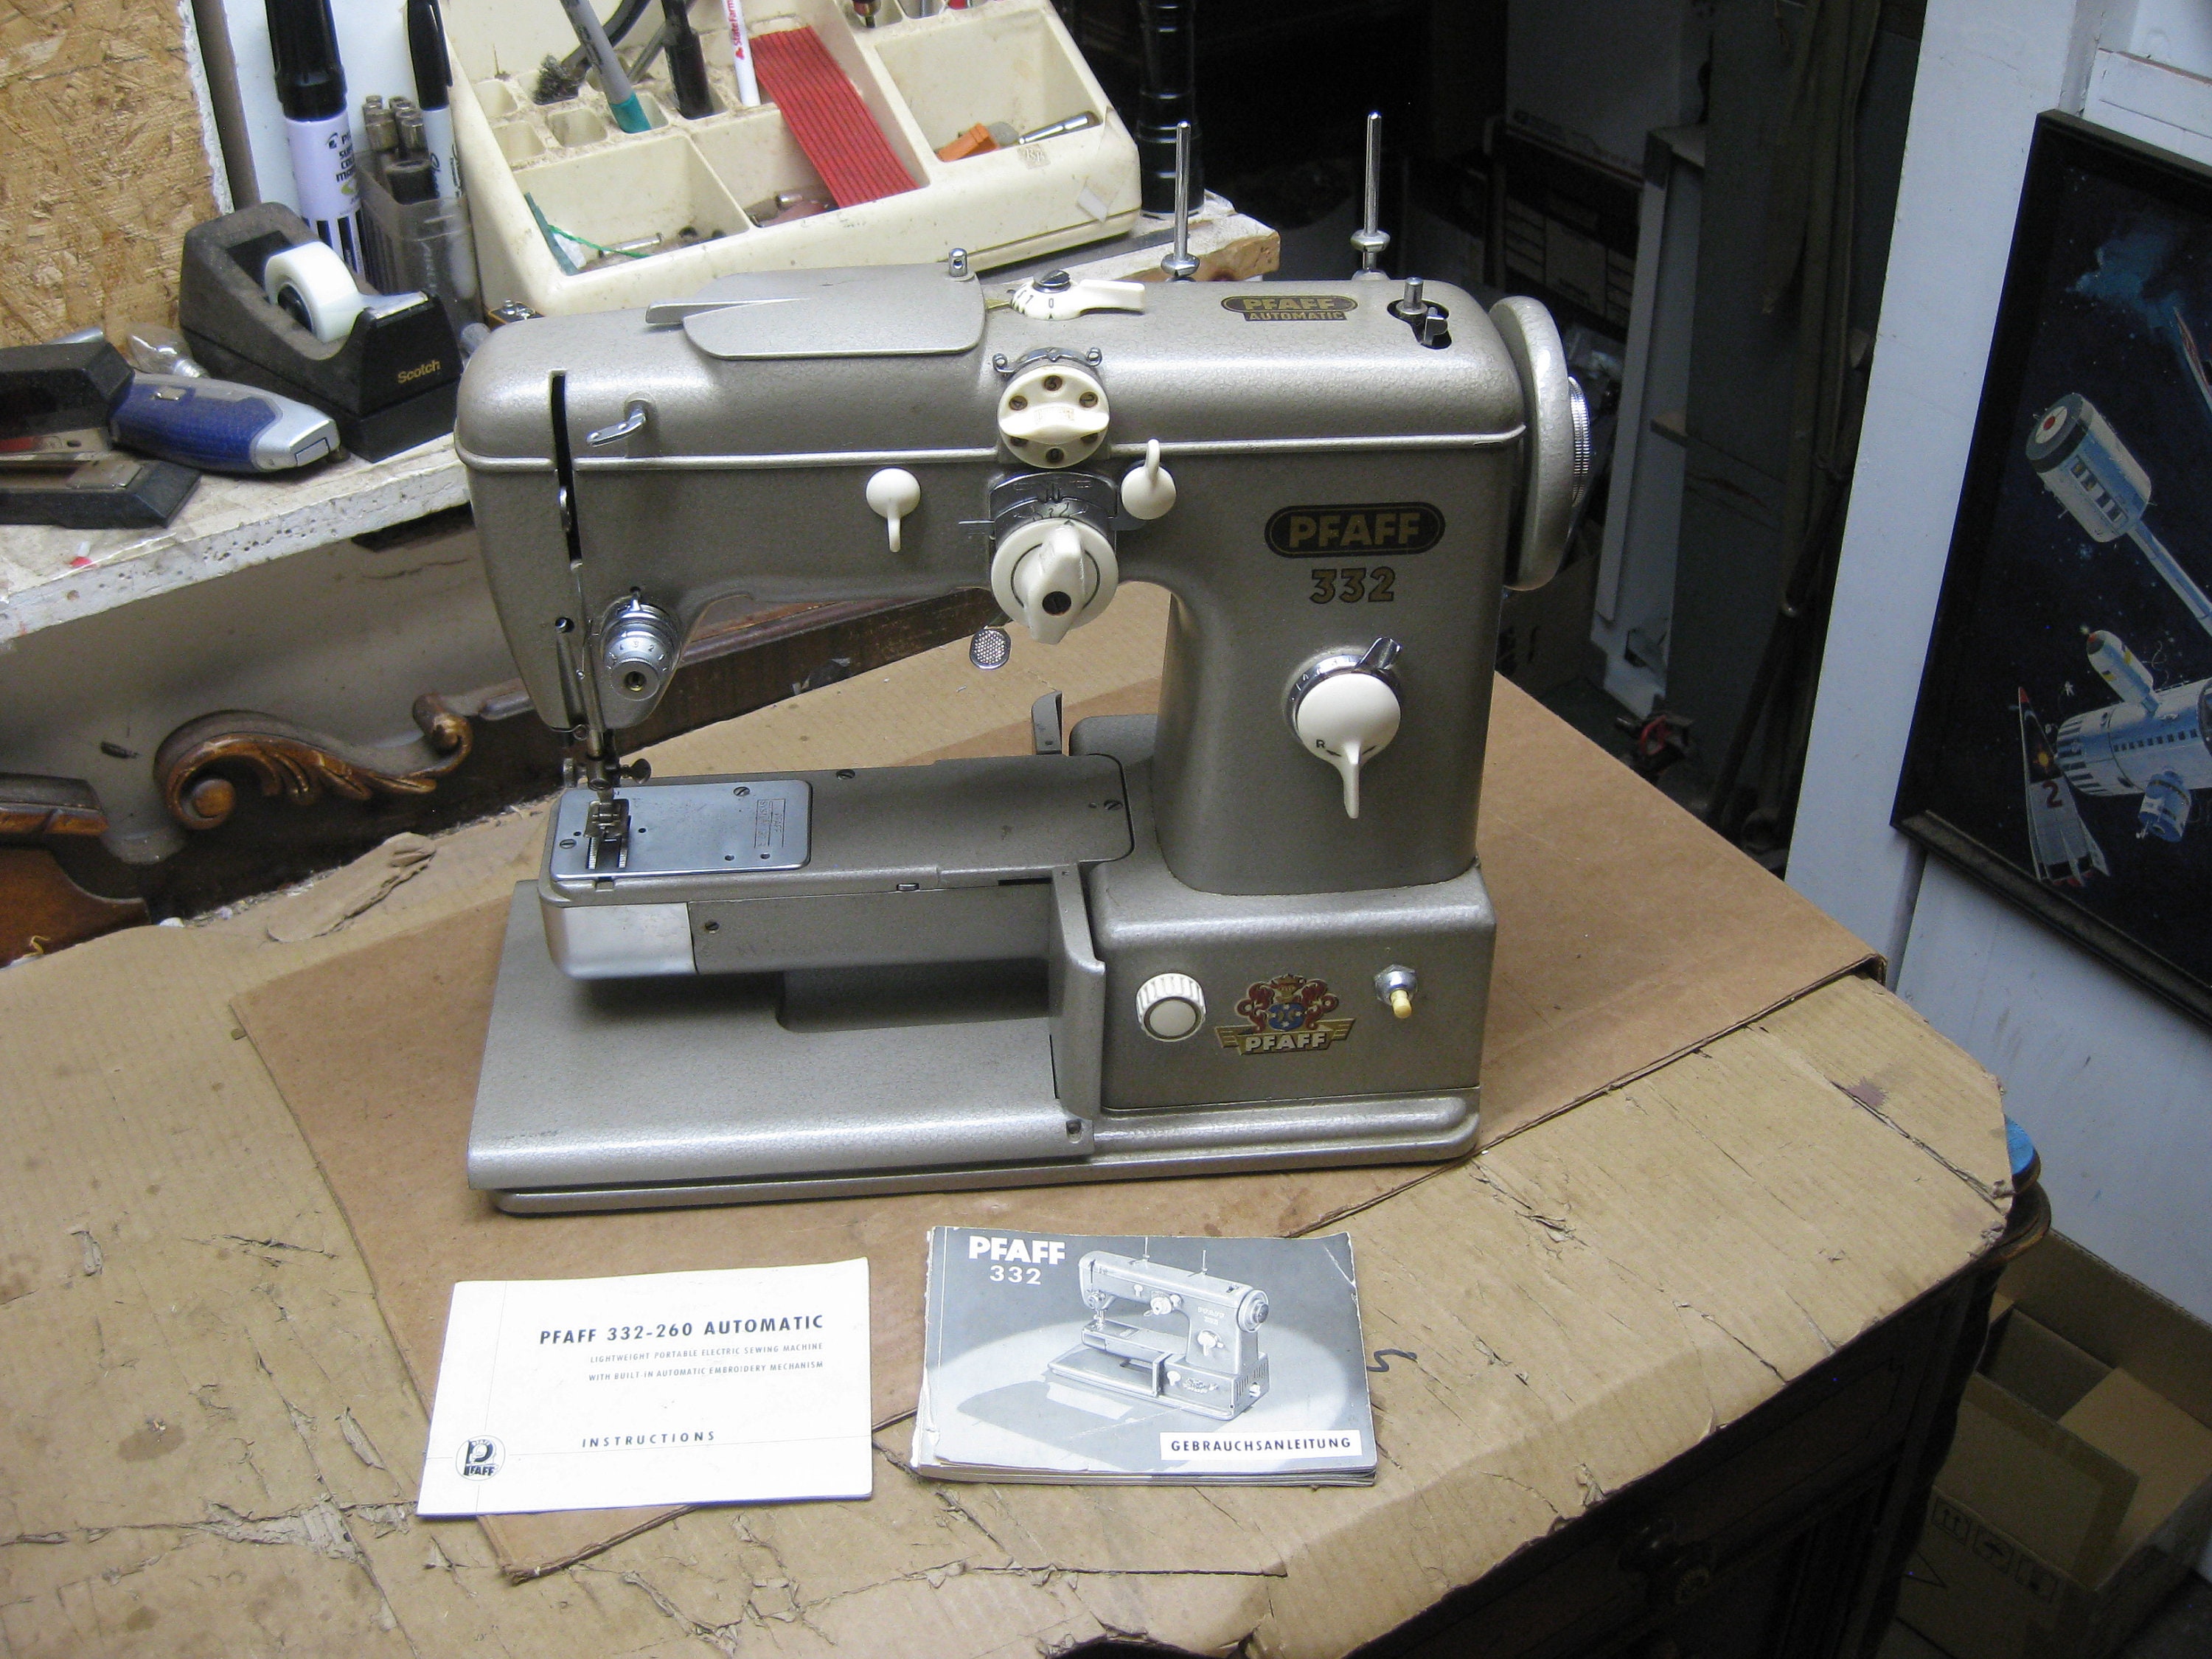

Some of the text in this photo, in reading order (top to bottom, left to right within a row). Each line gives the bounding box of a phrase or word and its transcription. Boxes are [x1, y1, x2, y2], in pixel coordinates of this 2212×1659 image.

[1243, 298, 1335, 310] PFAFF
[1248, 311, 1344, 320] AUTOMATIC
[397, 359, 441, 384] Scotch
[1289, 512, 1421, 548] PFAFF
[1310, 566, 1396, 604] 332
[1316, 740, 1326, 748] R
[2042, 780, 2062, 808] 2
[1245, 1032, 1326, 1052] PFAFF
[968, 1235, 1066, 1265] PFAFF
[990, 1265, 1041, 1285] 332
[540, 1315, 824, 1345] PFAFF 332-260 AUTOMATIC
[590, 1342, 823, 1363] LIGHTWEIGHT PORTABLE ELECTRIC SEWING MACHINE
[588, 1373, 611, 1381] WITH
[656, 1367, 706, 1377] AUTOMATIC
[709, 1364, 766, 1374] EMBROIDERY
[770, 1360, 824, 1371] MECHANISM
[582, 1431, 714, 1447] INSTRUCTIONS
[1171, 1437, 1351, 1452] GEBRAUCHSANLEITUNG
